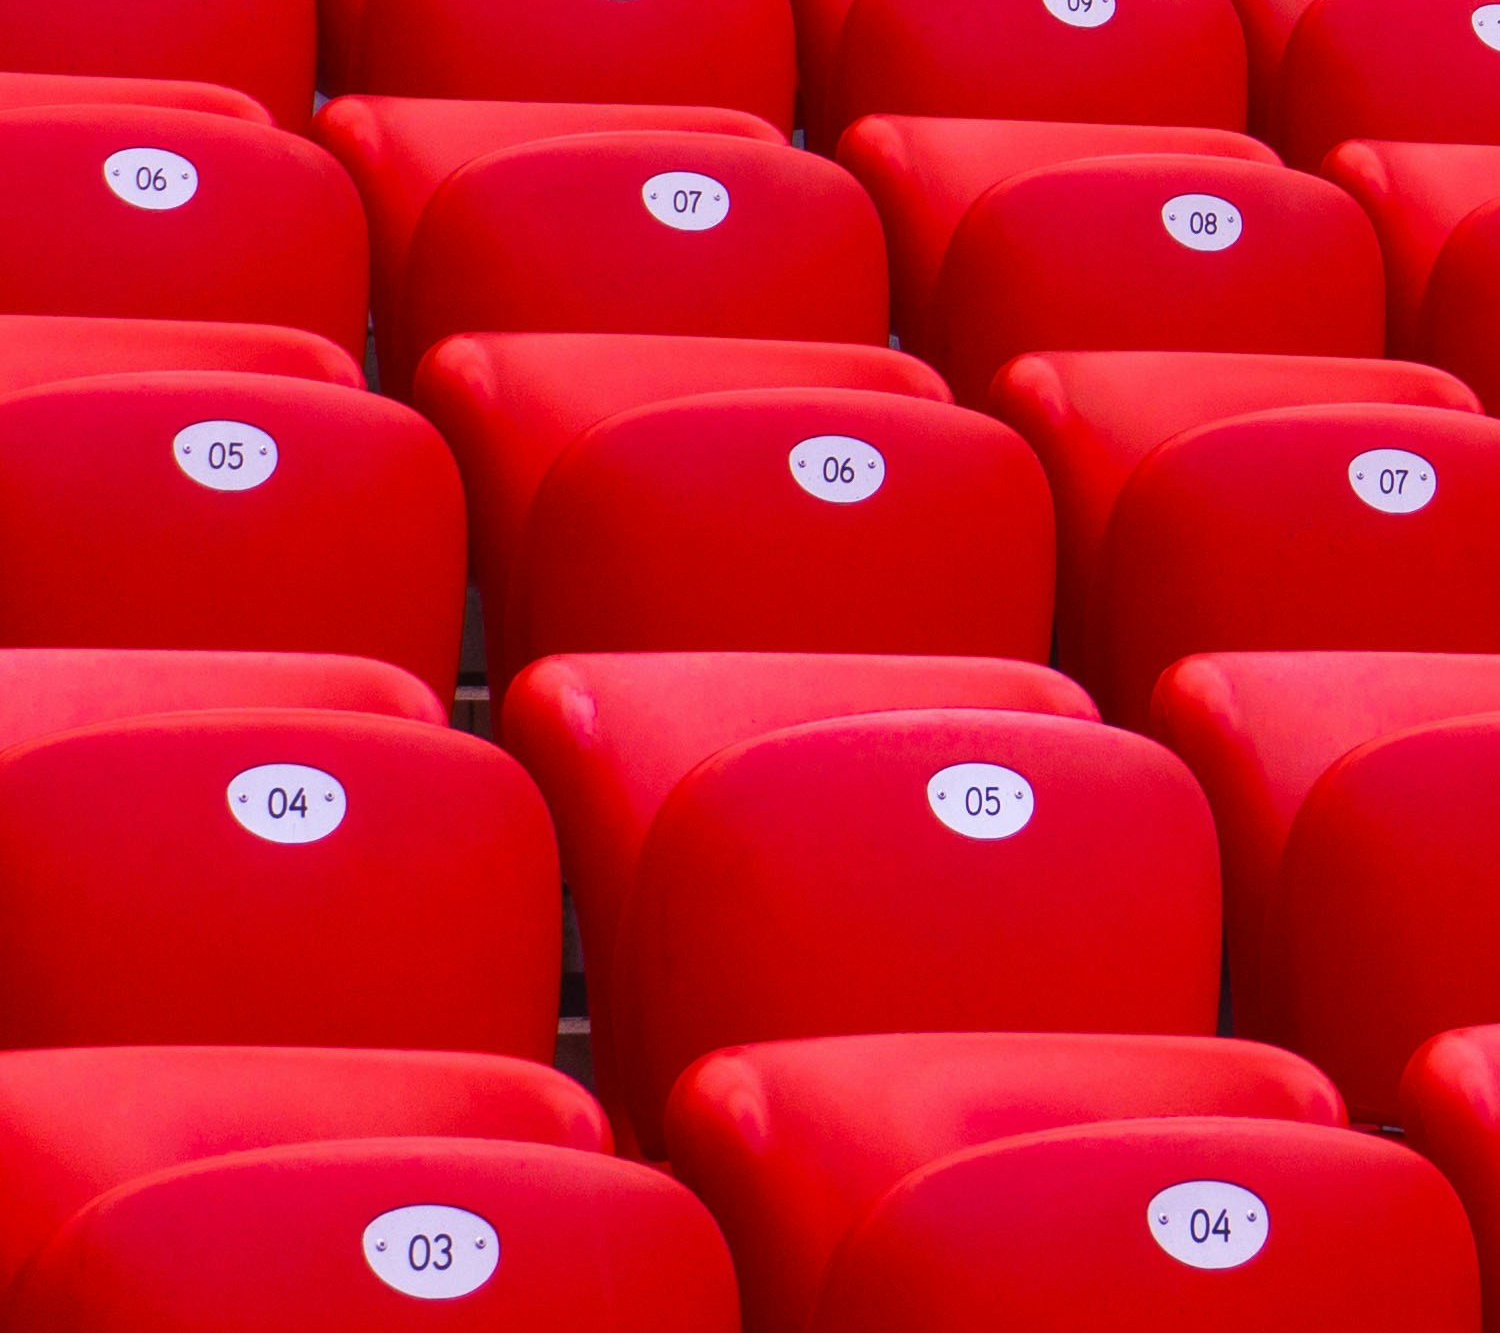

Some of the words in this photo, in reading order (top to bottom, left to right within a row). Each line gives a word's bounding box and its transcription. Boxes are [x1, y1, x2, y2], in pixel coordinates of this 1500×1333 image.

[135, 166, 167, 192] 06
[673, 189, 703, 214] 07
[1189, 211, 1218, 236] 08
[208, 441, 244, 471] 05
[822, 456, 855, 484] 06
[1379, 468, 1409, 495] 07
[267, 787, 308, 820] 04
[965, 786, 1001, 817] 05
[1190, 1208, 1232, 1244] 04
[408, 1233, 453, 1272] 03
